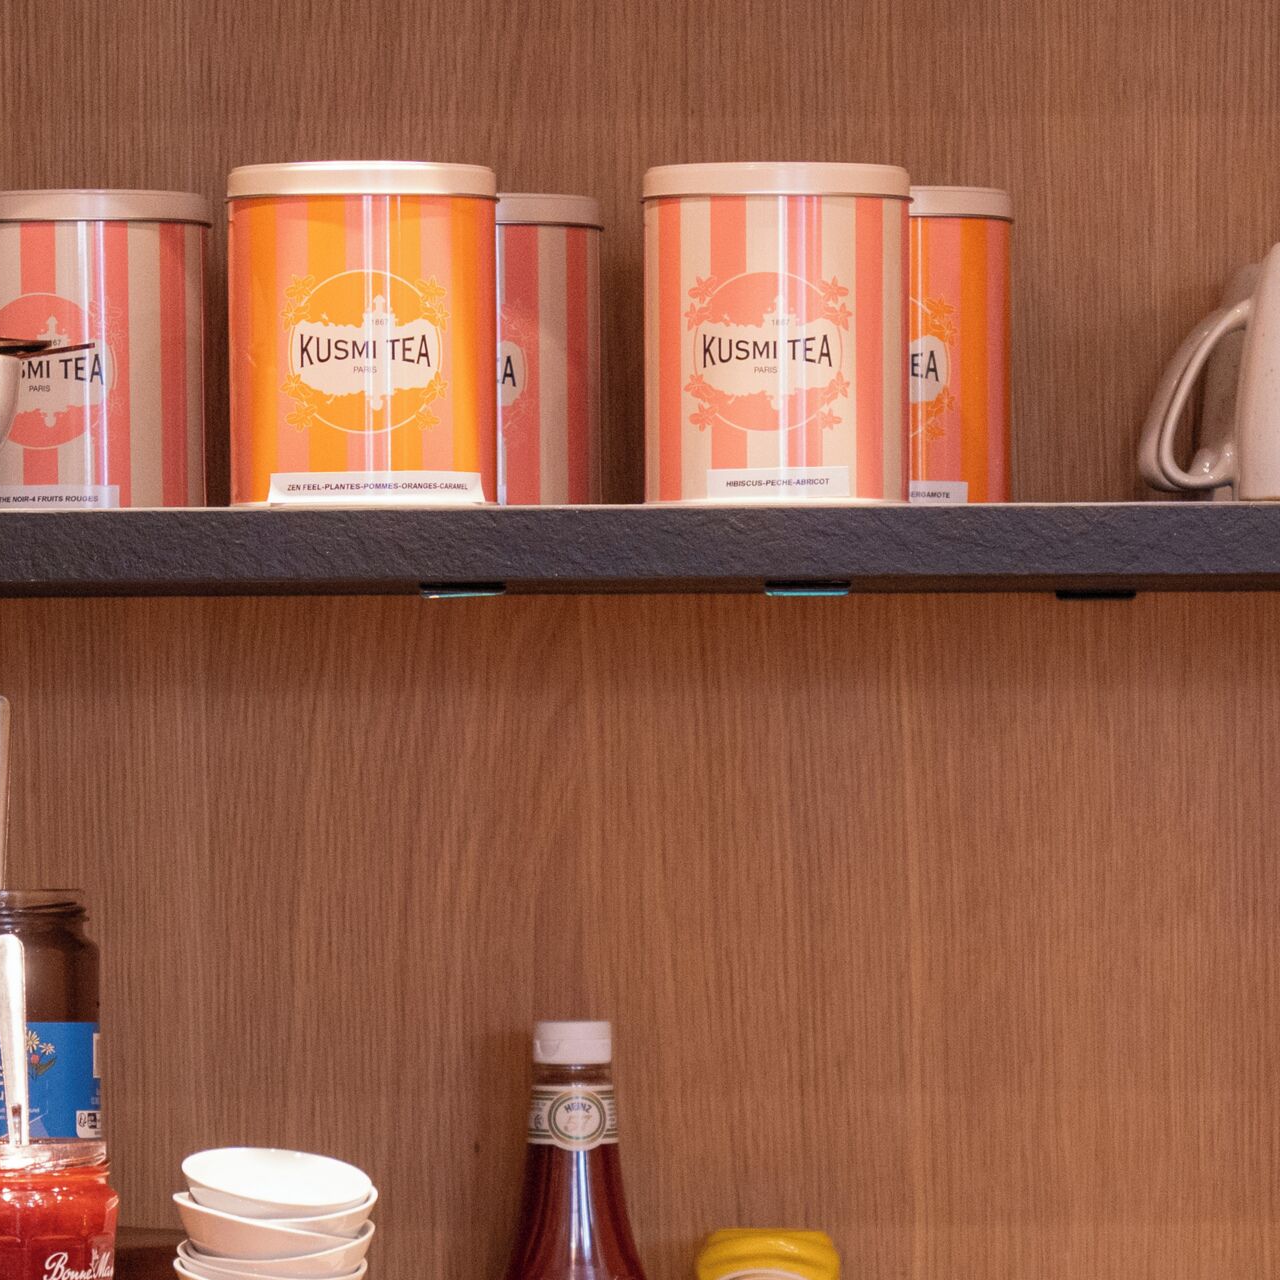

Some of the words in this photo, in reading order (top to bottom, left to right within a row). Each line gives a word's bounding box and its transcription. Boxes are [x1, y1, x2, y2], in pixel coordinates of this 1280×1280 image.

[299, 334, 377, 368] KUSMI
[386, 334, 431, 367] TEA
[702, 334, 778, 368] KUSMI
[787, 334, 833, 367] TEA
[59, 354, 104, 386] TEA
[353, 366, 378, 374] PARIS
[754, 366, 778, 374] PARIS
[911, 350, 940, 382] EA
[29, 385, 51, 393] PARIS
[287, 483, 301, 491] ZEN
[725, 477, 829, 488] HIBISCUS-PECHE-ABRICOT
[65, 495, 99, 503] ROUGES
[564, 1103, 593, 1113] HEINZ
